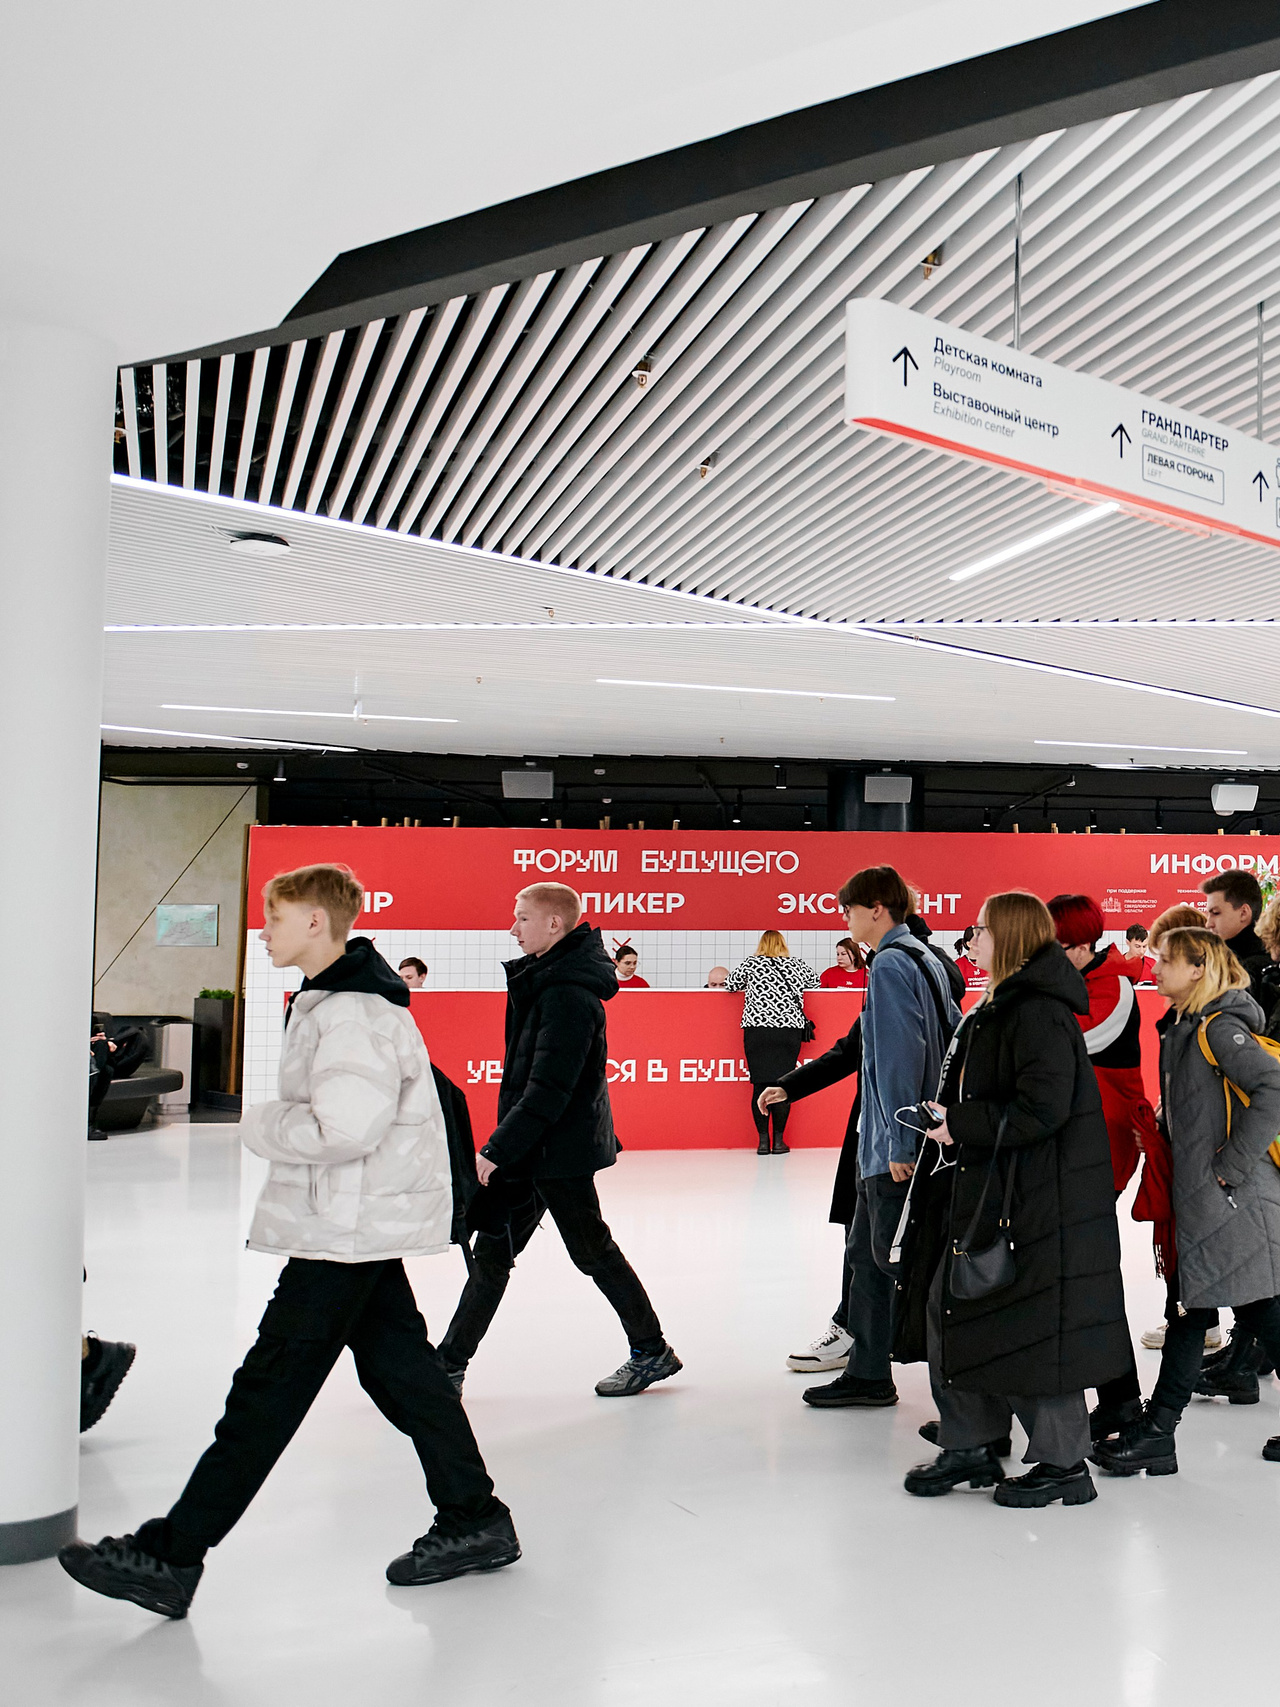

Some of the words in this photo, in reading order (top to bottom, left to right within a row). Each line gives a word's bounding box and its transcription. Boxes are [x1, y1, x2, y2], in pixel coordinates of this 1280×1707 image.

[933, 356, 982, 383] Playroom
[934, 336, 988, 369] Детская
[991, 359, 1044, 388] комната
[933, 381, 1022, 424] Выставочный
[1024, 415, 1060, 438] центр
[933, 401, 983, 428] Exhibition
[984, 420, 1016, 438] center
[1141, 409, 1182, 439] ГРАНД
[1184, 424, 1229, 452] ПАРТЕР
[1141, 427, 1168, 445] GRAND
[1169, 438, 1207, 458] PARTERRE
[1147, 453, 1175, 470] ЛЕВАЯ
[1176, 462, 1215, 483] СТОРОНА
[1147, 467, 1162, 479] LEFT
[513, 849, 618, 872] ФОРУМ
[641, 850, 800, 876] БУДУЩЕГО
[363, 891, 394, 913] IP
[581, 892, 685, 913] ПИКЕР
[647, 1060, 668, 1082] В
